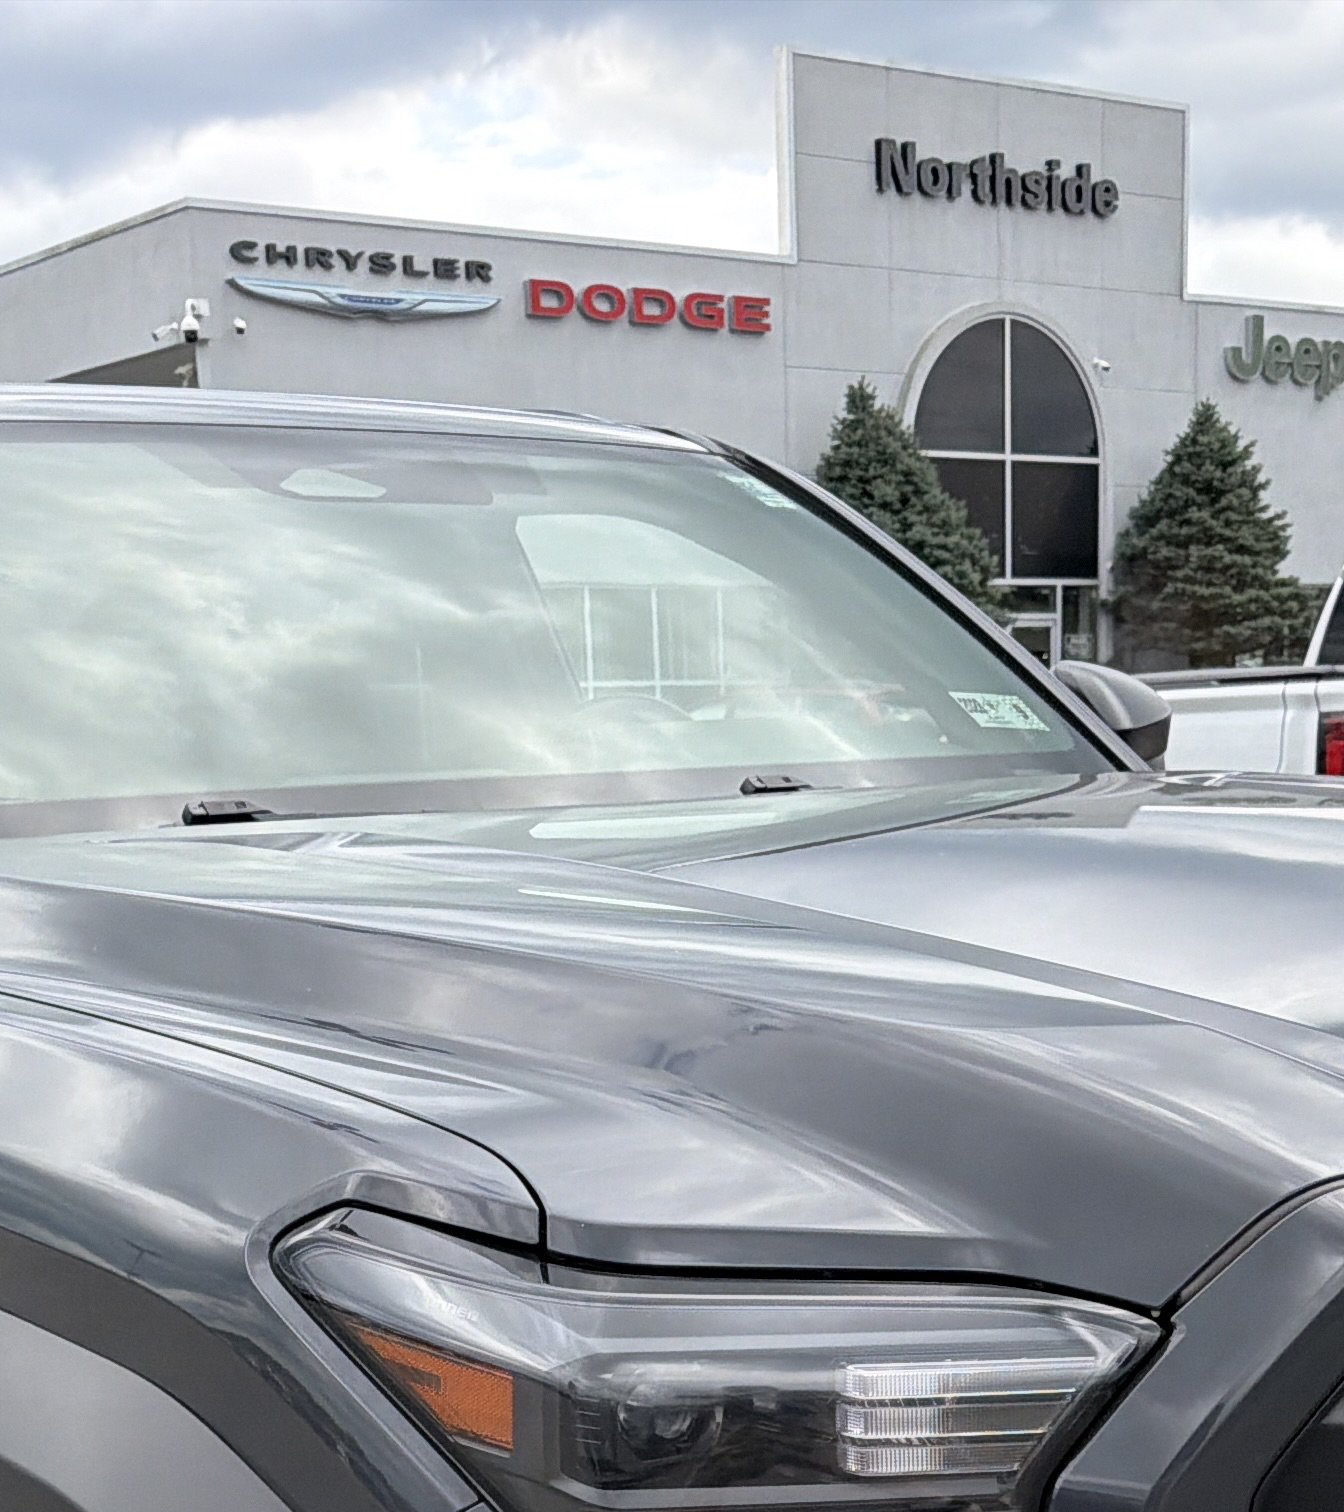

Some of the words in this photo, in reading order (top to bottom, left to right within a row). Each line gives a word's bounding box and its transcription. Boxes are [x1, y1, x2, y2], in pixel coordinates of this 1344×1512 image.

[874, 137, 1120, 219] Northside
[228, 239, 494, 283] CHRYSLER
[525, 278, 772, 334] DODGE
